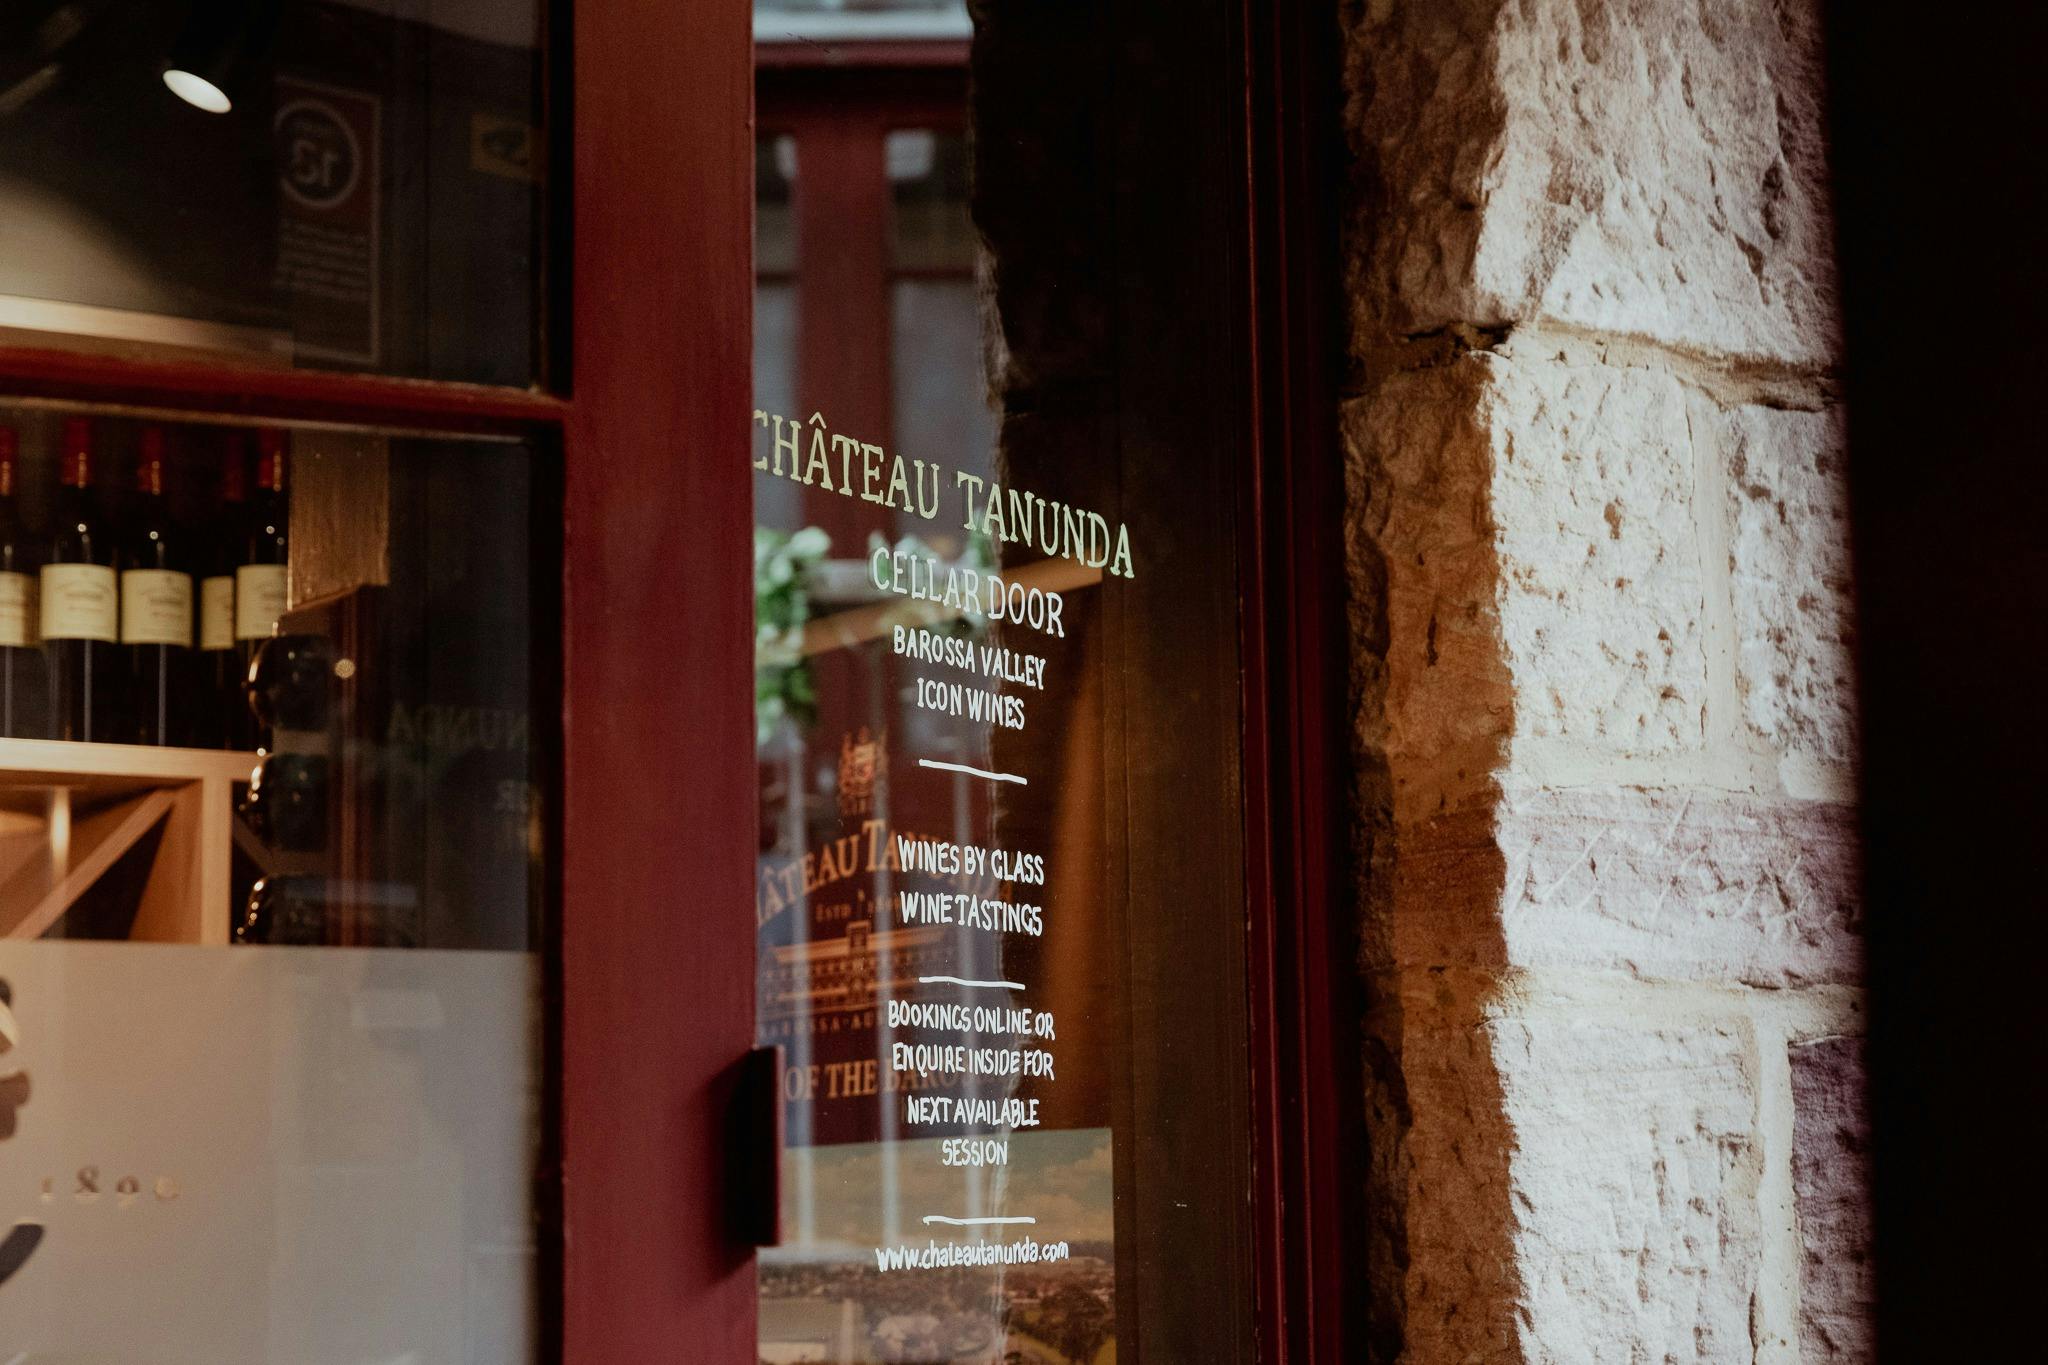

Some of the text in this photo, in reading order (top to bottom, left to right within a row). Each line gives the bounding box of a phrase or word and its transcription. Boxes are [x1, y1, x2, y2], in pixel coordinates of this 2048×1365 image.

[754, 409, 1135, 579] CHÂTEAU TANUNDA
[872, 546, 1065, 638] CELLAR DOOR
[893, 624, 1046, 690] BAROSSA VALLEY
[917, 677, 1025, 730] ICON WINES
[897, 835, 1044, 885] WINES BY GLASS
[900, 891, 954, 924] WINE
[954, 894, 1043, 937] TASTINGS
[888, 999, 972, 1033] BOOKINGS
[973, 1005, 1033, 1035] ONLINE
[1034, 1012, 1056, 1041] OR
[784, 1065, 819, 1101] OF
[824, 1059, 878, 1098] THE
[892, 1042, 1055, 1081] ENQUIRE INSIDE FOR
[907, 1095, 1040, 1129] NEXT AVAILABLE
[941, 1138, 1008, 1168] SESSION
